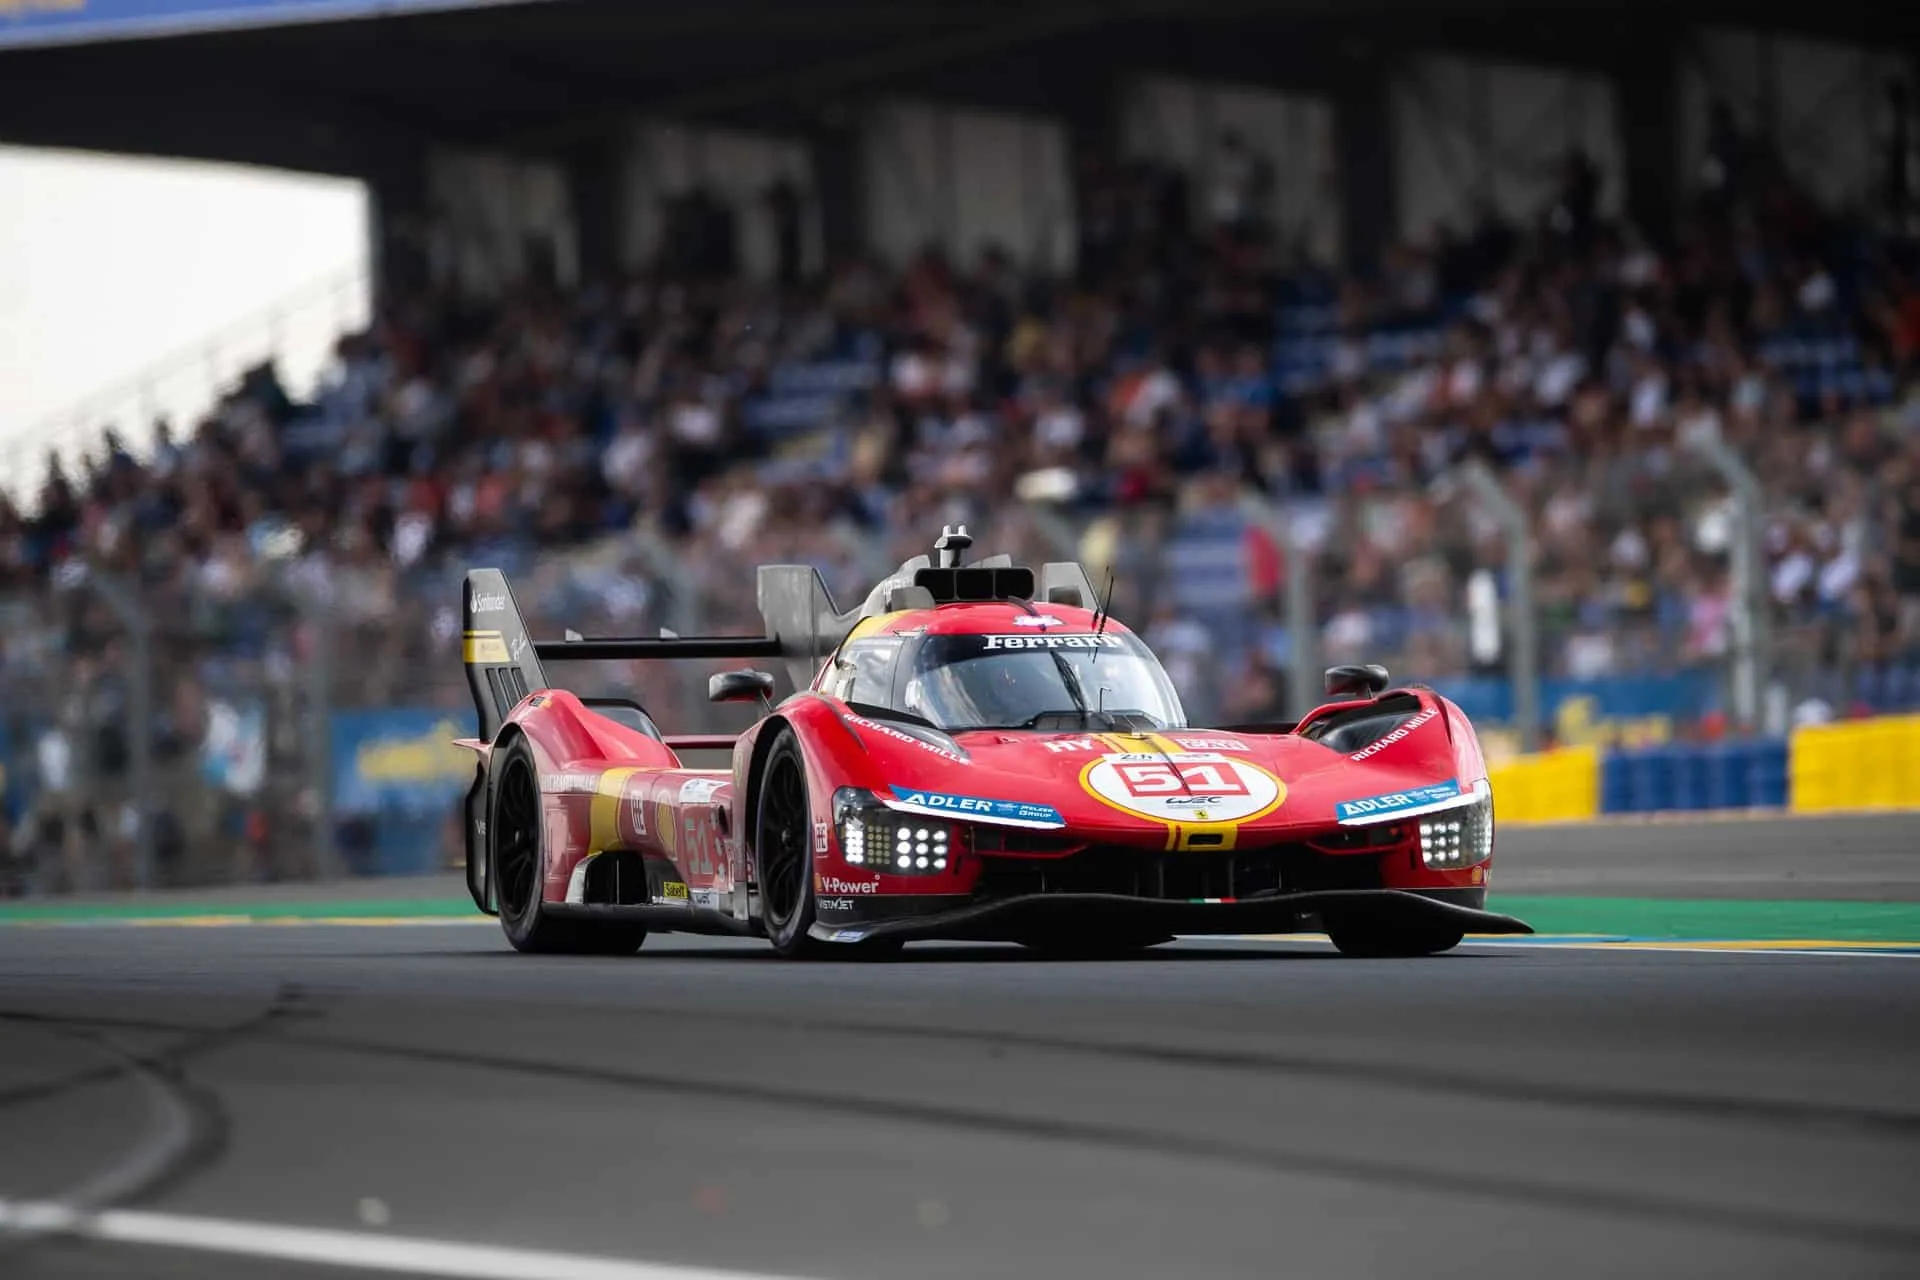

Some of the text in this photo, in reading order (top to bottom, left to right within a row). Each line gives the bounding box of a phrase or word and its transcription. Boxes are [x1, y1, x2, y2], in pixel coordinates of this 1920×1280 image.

[982, 633, 1121, 650] Ferrari
[844, 714, 915, 742] RICHARD
[1352, 707, 1438, 761] RICHARD MILLE
[1122, 765, 1241, 792] 51
[903, 793, 993, 812] ADLER
[1166, 796, 1224, 804] WEC
[1343, 794, 1413, 815] ADLER
[684, 816, 714, 876] 51
[822, 876, 879, 893] V-Power
